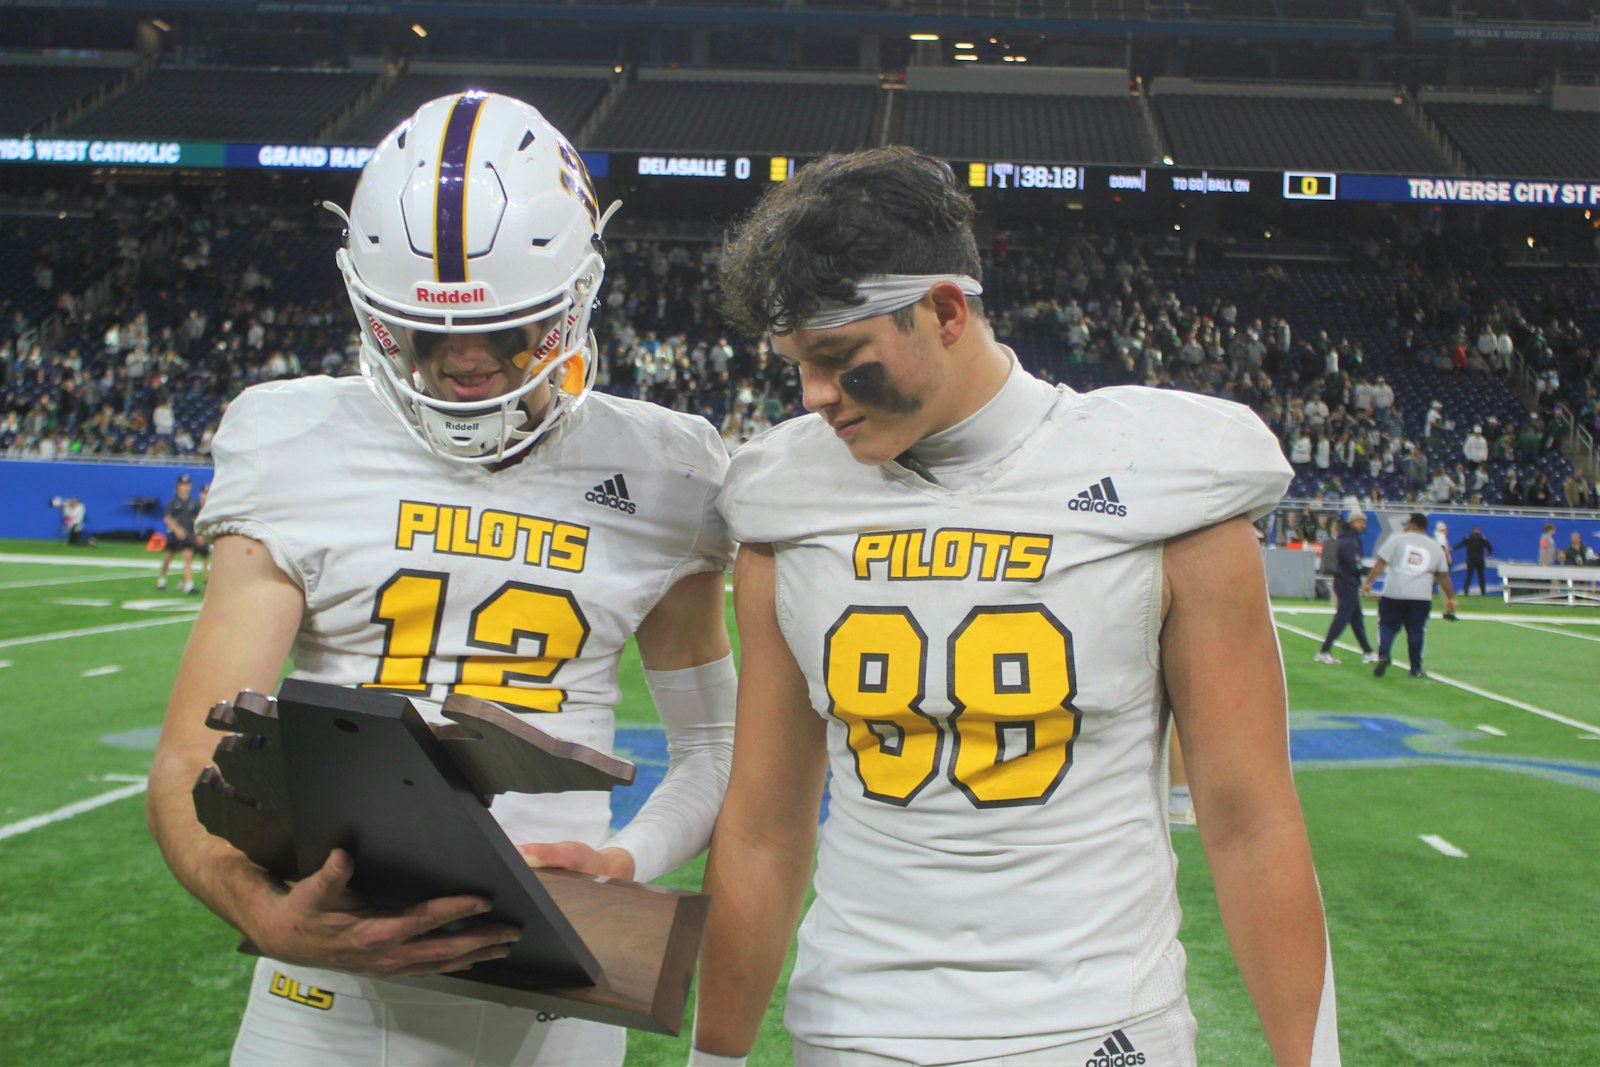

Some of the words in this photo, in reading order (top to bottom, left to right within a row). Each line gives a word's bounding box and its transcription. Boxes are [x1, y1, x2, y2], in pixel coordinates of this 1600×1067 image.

[35, 139, 90, 162] WEST
[89, 141, 181, 164] CATHOLIC
[258, 145, 329, 168] GRAND
[329, 147, 375, 168] RAP
[638, 157, 727, 177] DELASALLE
[735, 157, 750, 180] 0
[1020, 165, 1077, 189] 38:18
[1109, 175, 1141, 189] DOWN
[1172, 177, 1187, 191] TO
[1188, 178, 1203, 191] GO
[1207, 178, 1232, 192] BALL
[1233, 179, 1250, 192] ON
[1301, 176, 1318, 196] 0
[1408, 178, 1511, 202] TRAVERSE
[1513, 181, 1560, 204] CITY
[1560, 183, 1588, 205] ST
[416, 287, 485, 304] Riddell
[367, 312, 400, 357] iddell
[532, 314, 577, 361] Riddll
[445, 421, 480, 432] Riddell
[584, 489, 637, 515] adidas
[1067, 497, 1128, 517] adidas
[395, 499, 591, 574] PILOTS
[853, 527, 1054, 583] PILOTS
[360, 567, 592, 713] 12
[822, 602, 1084, 810] 88
[1085, 1052, 1147, 1067] adidas
